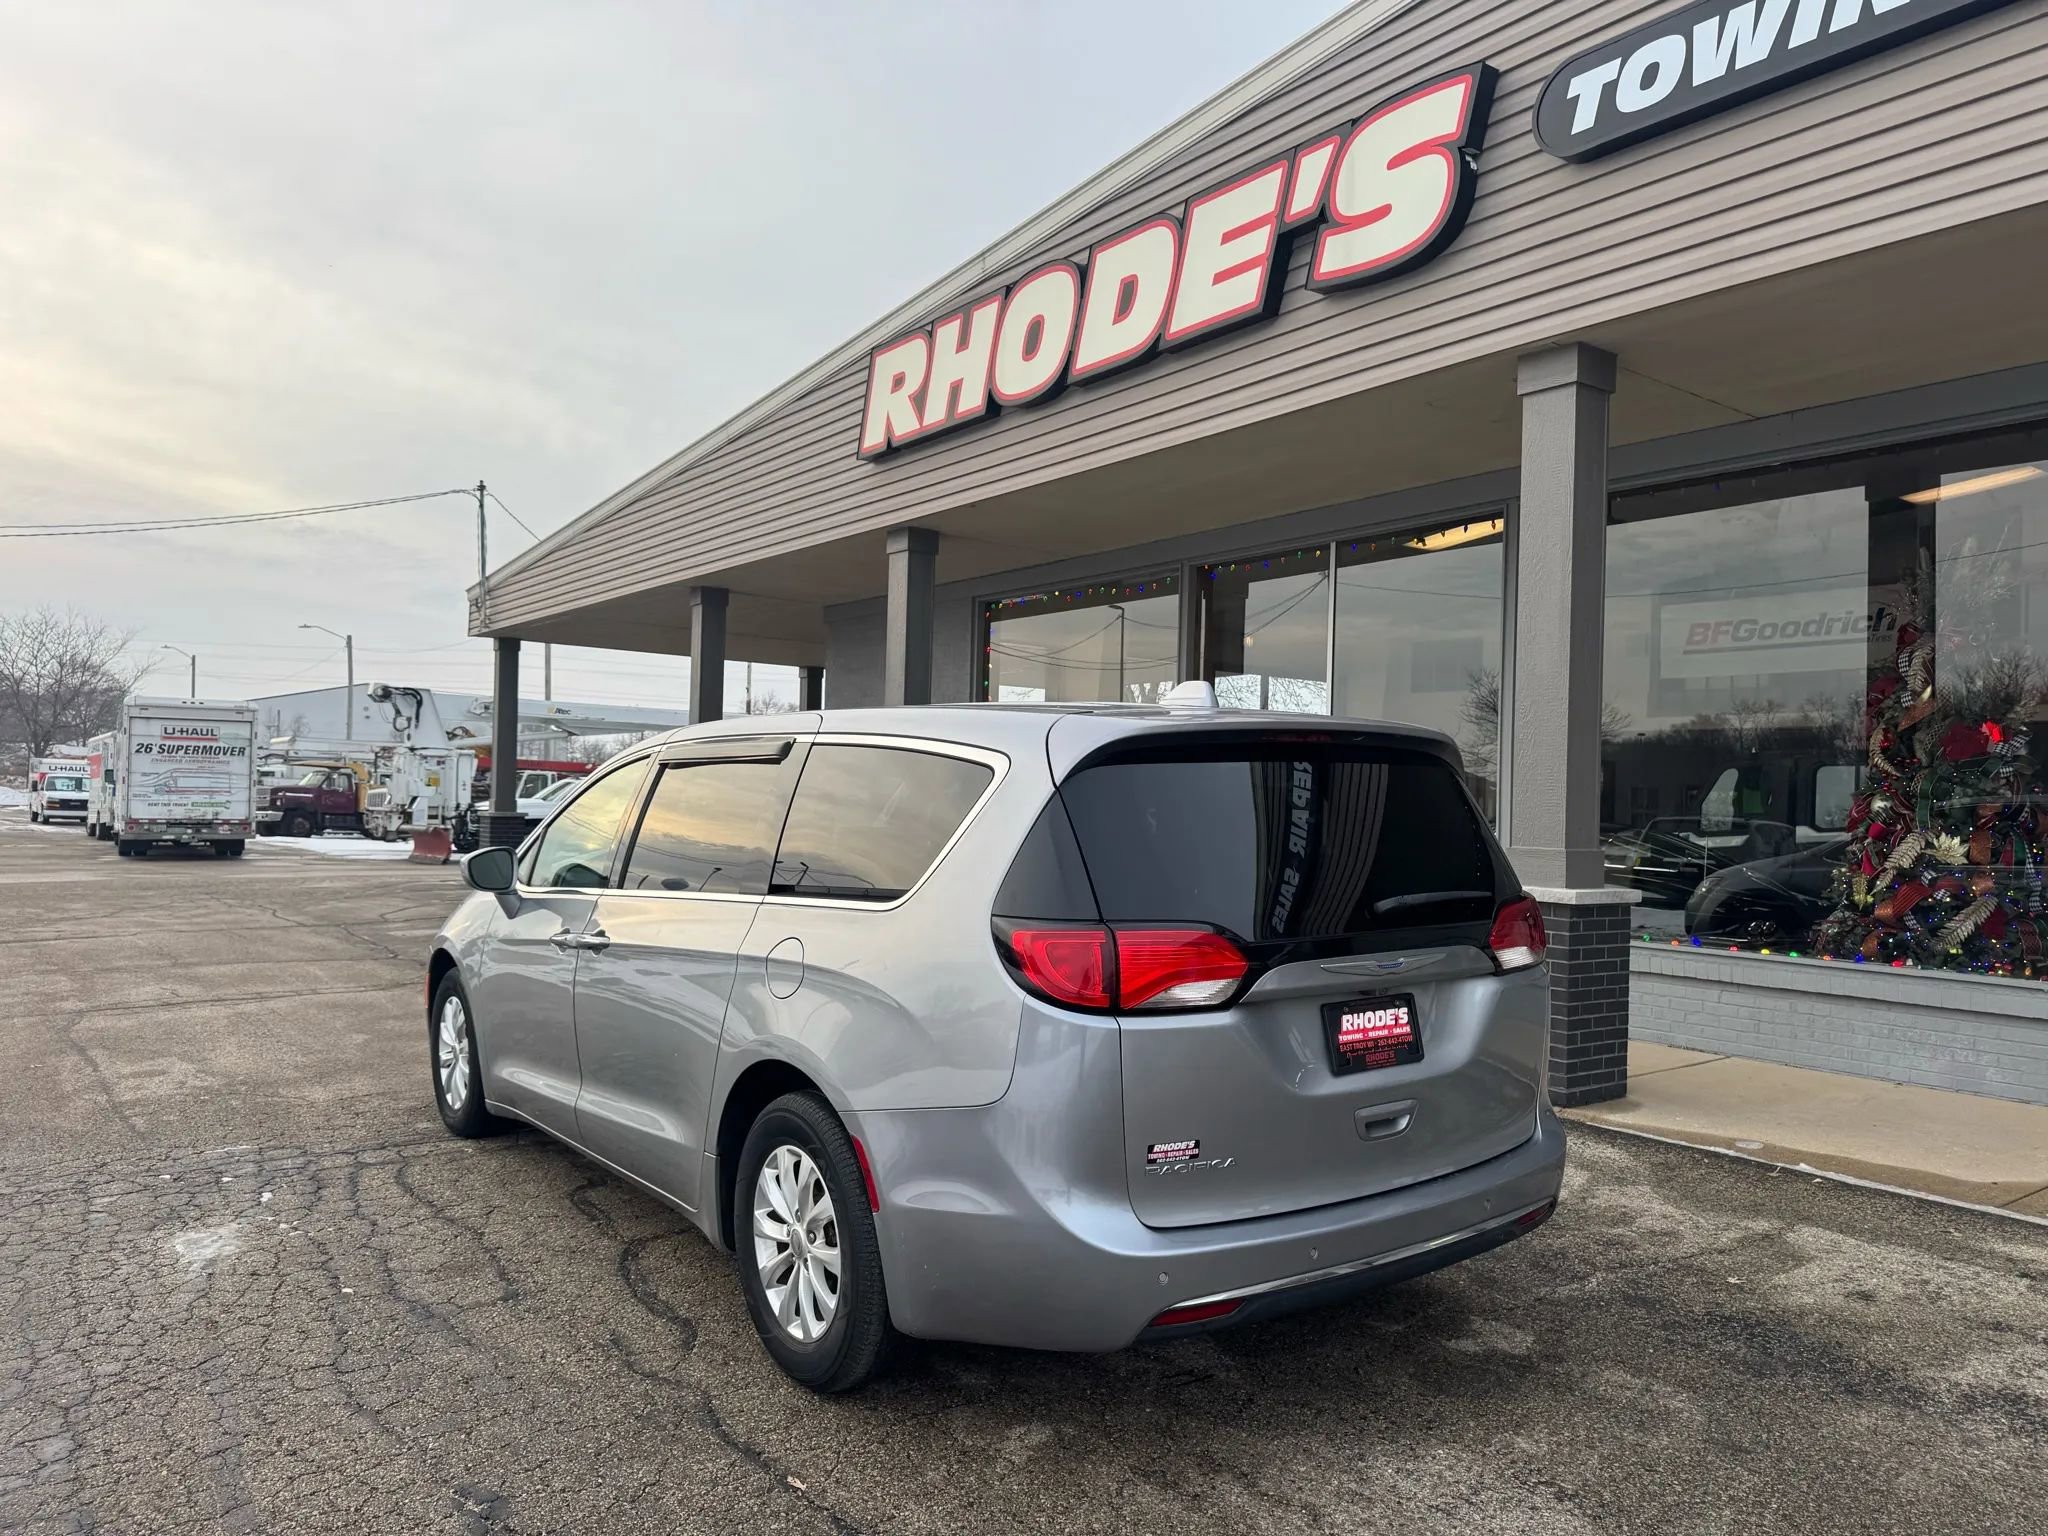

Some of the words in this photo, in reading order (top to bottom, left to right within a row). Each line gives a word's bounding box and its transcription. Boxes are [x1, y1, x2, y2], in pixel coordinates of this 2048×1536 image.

[861, 72, 1475, 454] RHODE'S
[1685, 607, 1897, 646] BFGoodrich
[164, 726, 218, 737] U-HAUL
[48, 764, 88, 773] U-HAUL
[1342, 1007, 1409, 1032] RHODE'S
[1338, 1032, 1364, 1042] TOWING
[1368, 1029, 1389, 1038] REPAIR
[1393, 1025, 1411, 1034] SALES
[1153, 1140, 1196, 1153] RHODE'S
